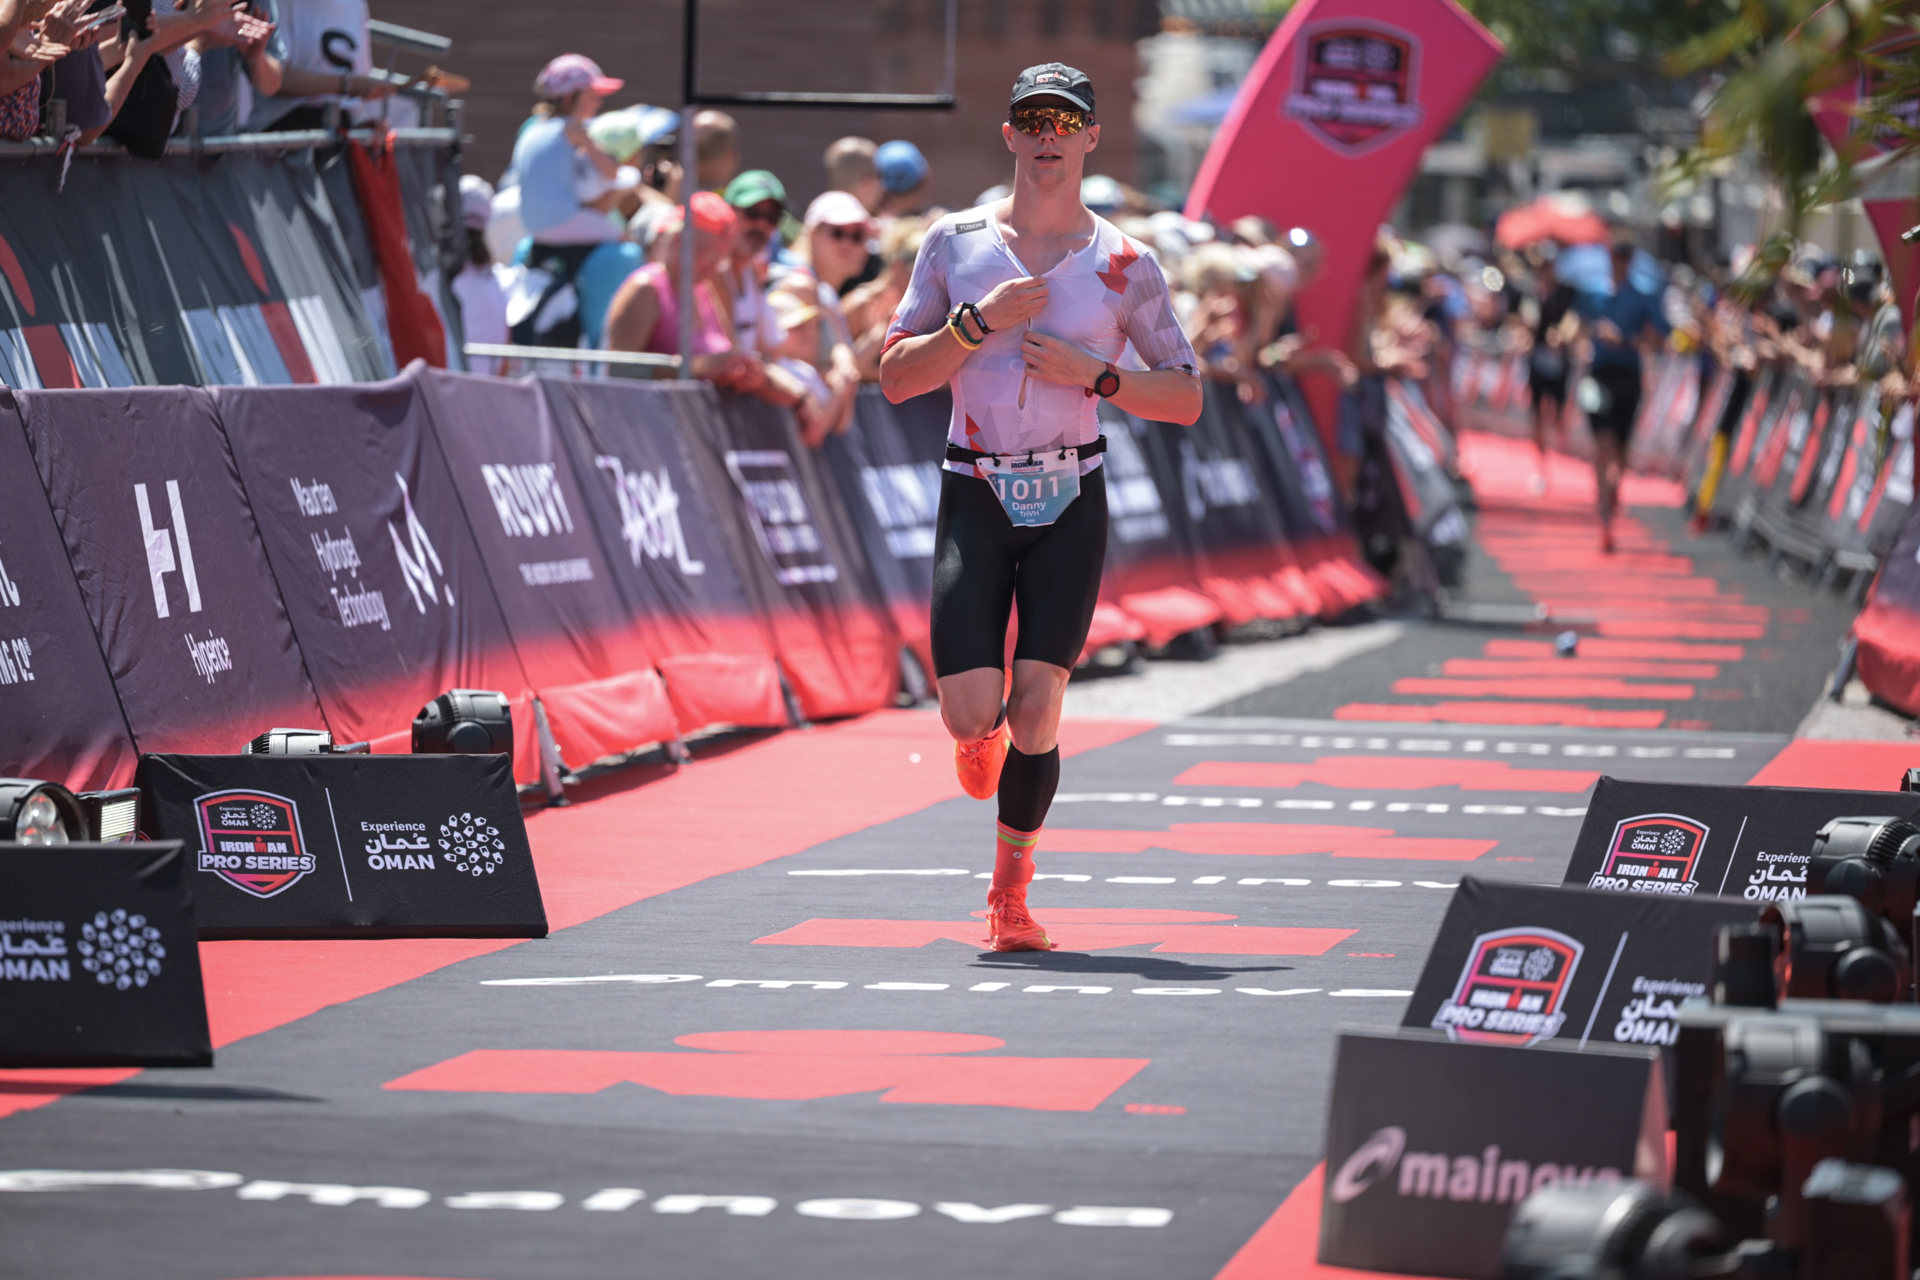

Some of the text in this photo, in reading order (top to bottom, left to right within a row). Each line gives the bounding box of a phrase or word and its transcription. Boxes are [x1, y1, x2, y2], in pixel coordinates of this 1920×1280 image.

[1011, 460, 1044, 468] IRONAN
[998, 476, 1059, 501] 1011
[1012, 501, 1047, 511] Danny
[184, 629, 233, 684] Hyperice
[1162, 794, 1590, 817] mainov
[360, 821, 426, 833] Experience
[220, 836, 288, 853] IRONMAN
[1631, 842, 1657, 851] OMAN
[201, 855, 312, 870] PRO SERIES
[367, 854, 436, 871] OMAN
[1756, 851, 1812, 864] Experienc
[1616, 861, 1679, 879] IRONMAN
[1591, 876, 1694, 897] PRO SERIES
[0, 959, 71, 981] MAN
